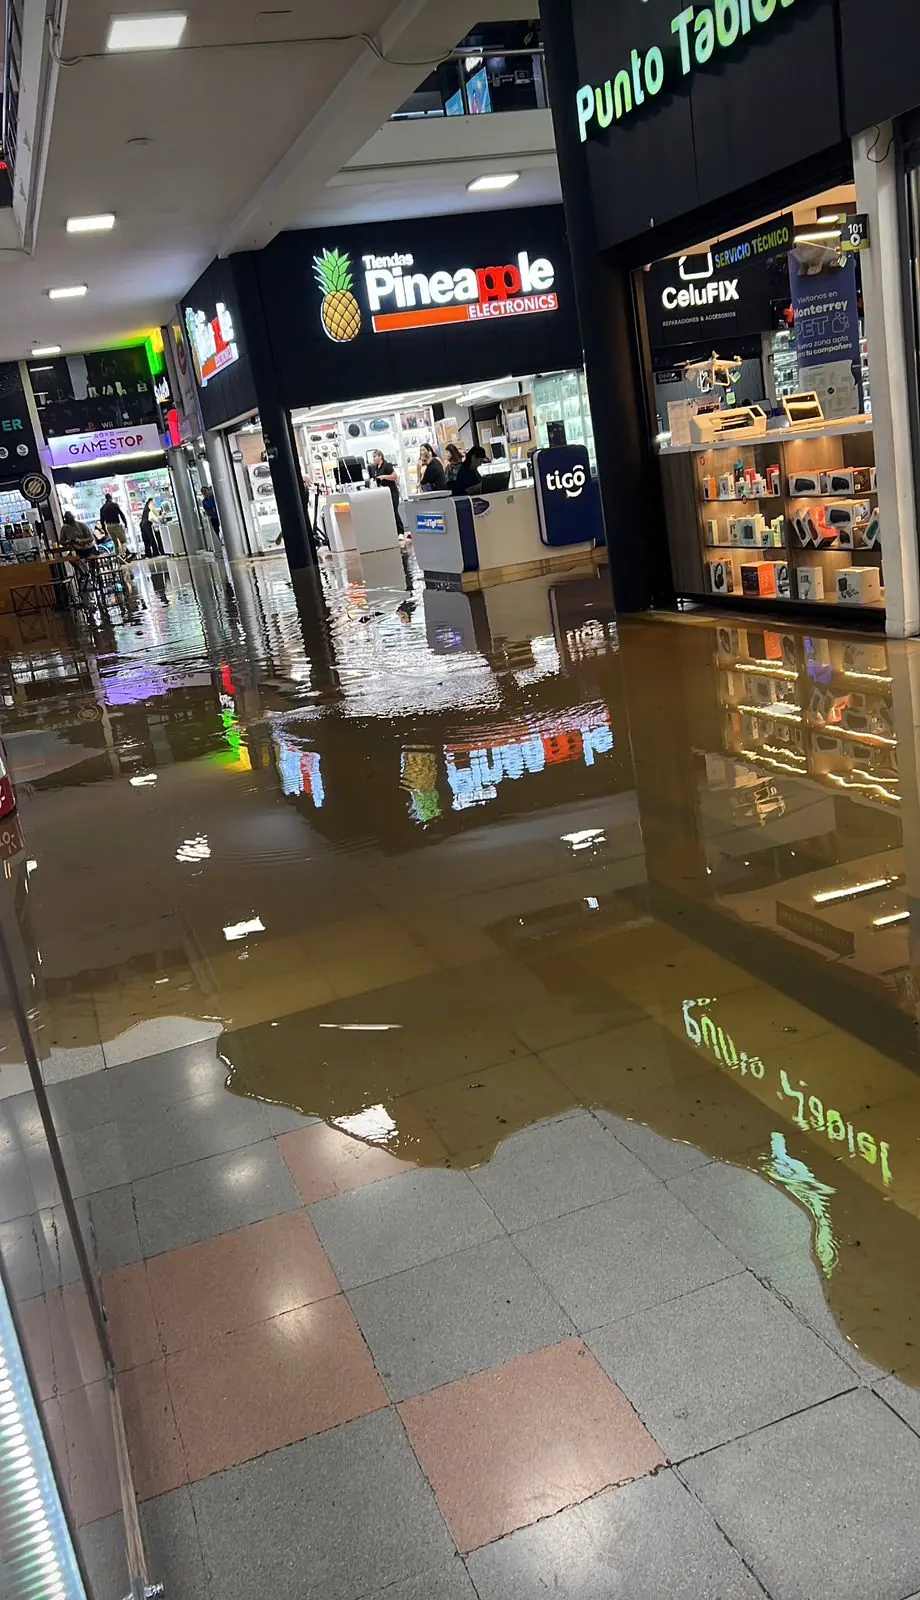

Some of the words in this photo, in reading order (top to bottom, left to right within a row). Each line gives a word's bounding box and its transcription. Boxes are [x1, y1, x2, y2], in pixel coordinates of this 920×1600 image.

[576, 46, 664, 143] Punto
[671, 0, 796, 76] Tabl
[847, 223, 863, 234] 101
[714, 243, 751, 268] SERVICIO
[752, 227, 789, 254] TÉCNICO
[361, 252, 414, 270] Tiendas
[364, 250, 555, 312] Pineapple
[468, 294, 556, 319] ELECTRONICS
[661, 279, 740, 309] CeluFIX
[814, 338, 831, 346] zona
[832, 335, 849, 344] apta
[0, 418, 24, 432] ER
[101, 421, 114, 429] Wii
[546, 466, 586, 498] tigo
